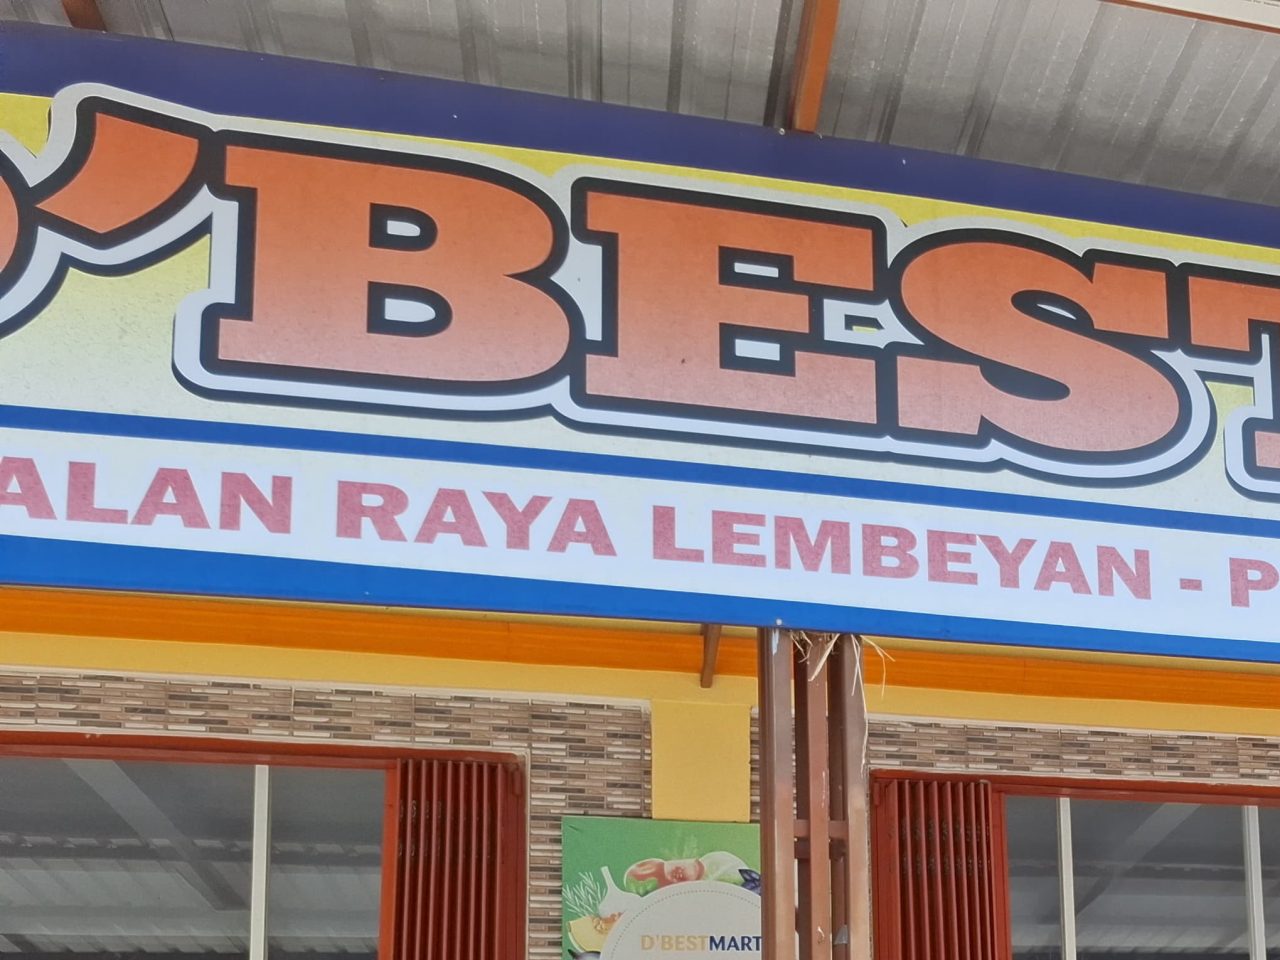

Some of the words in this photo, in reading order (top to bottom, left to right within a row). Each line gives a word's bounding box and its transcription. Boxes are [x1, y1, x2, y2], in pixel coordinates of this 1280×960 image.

[336, 479, 617, 557] RAYA
[652, 505, 1152, 600] LEMBEYAN
[1180, 578, 1204, 592] -
